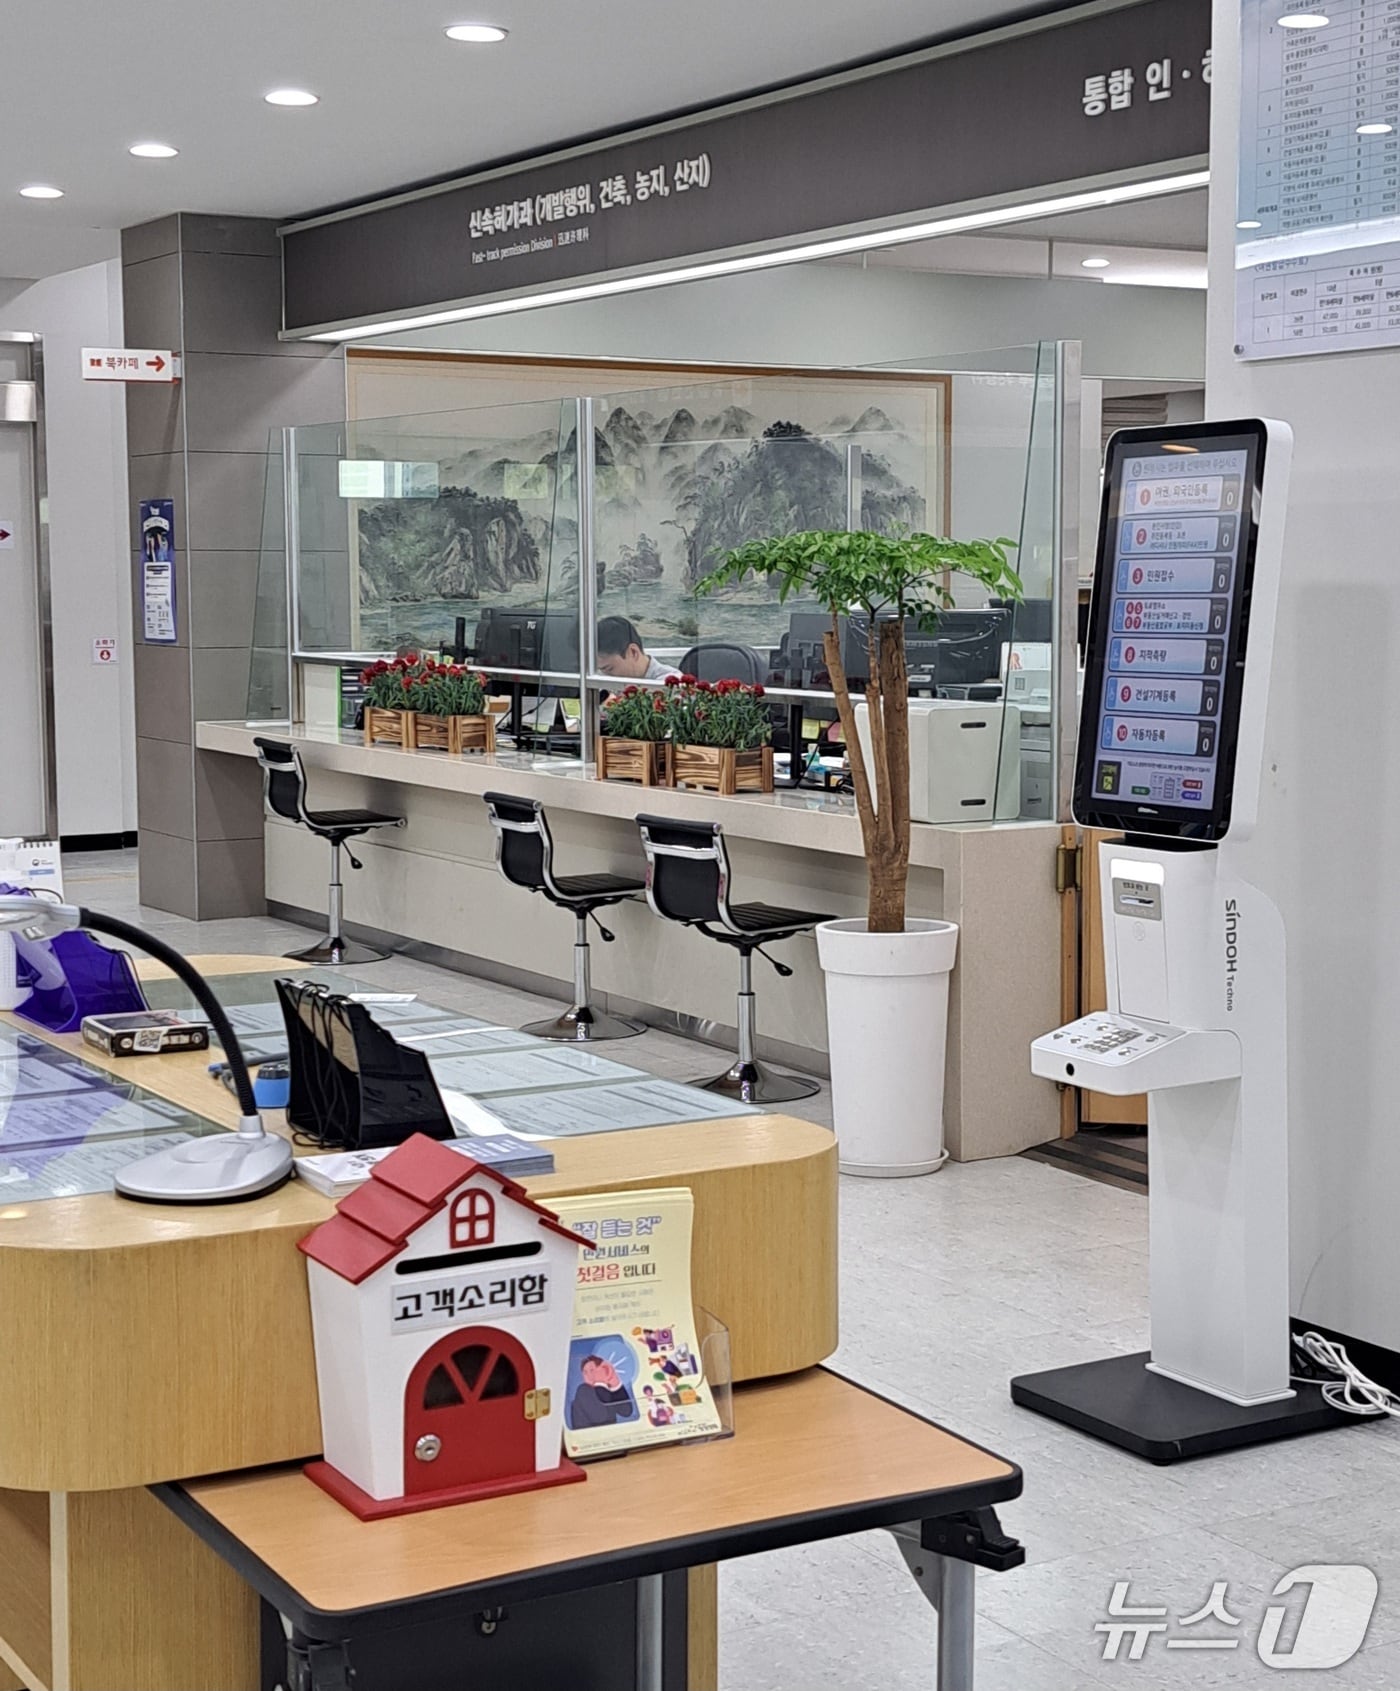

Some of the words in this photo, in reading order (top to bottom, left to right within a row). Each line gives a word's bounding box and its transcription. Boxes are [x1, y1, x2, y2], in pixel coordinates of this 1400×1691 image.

[1082, 68, 1135, 116] 통합
[599, 174, 632, 210] 건축,
[635, 164, 670, 200] 농지,
[673, 152, 712, 193] 산지)
[500, 241, 531, 261] permission
[531, 236, 553, 252] Division
[105, 356, 139, 371] 북카페
[1173, 483, 1209, 497] 외국인등록
[1226, 491, 1234, 505] 0
[1222, 533, 1230, 547] 0
[1147, 570, 1175, 582] 민원접수
[1218, 574, 1226, 588] 0
[1214, 615, 1221, 629] 0
[1139, 649, 1167, 662] 지적측량
[1210, 656, 1217, 670] 0
[1135, 688, 1176, 703] 건설기계등록
[1206, 697, 1213, 711] 0
[1131, 728, 1165, 742] 자동차등록
[1202, 738, 1209, 752] 0
[1226, 975, 1235, 1012] Techno
[600, 1218, 633, 1240] 듣는
[576, 1263, 621, 1284] 첫걸음
[623, 1262, 656, 1279] 입니다
[394, 1273, 548, 1321] 고객소리함
